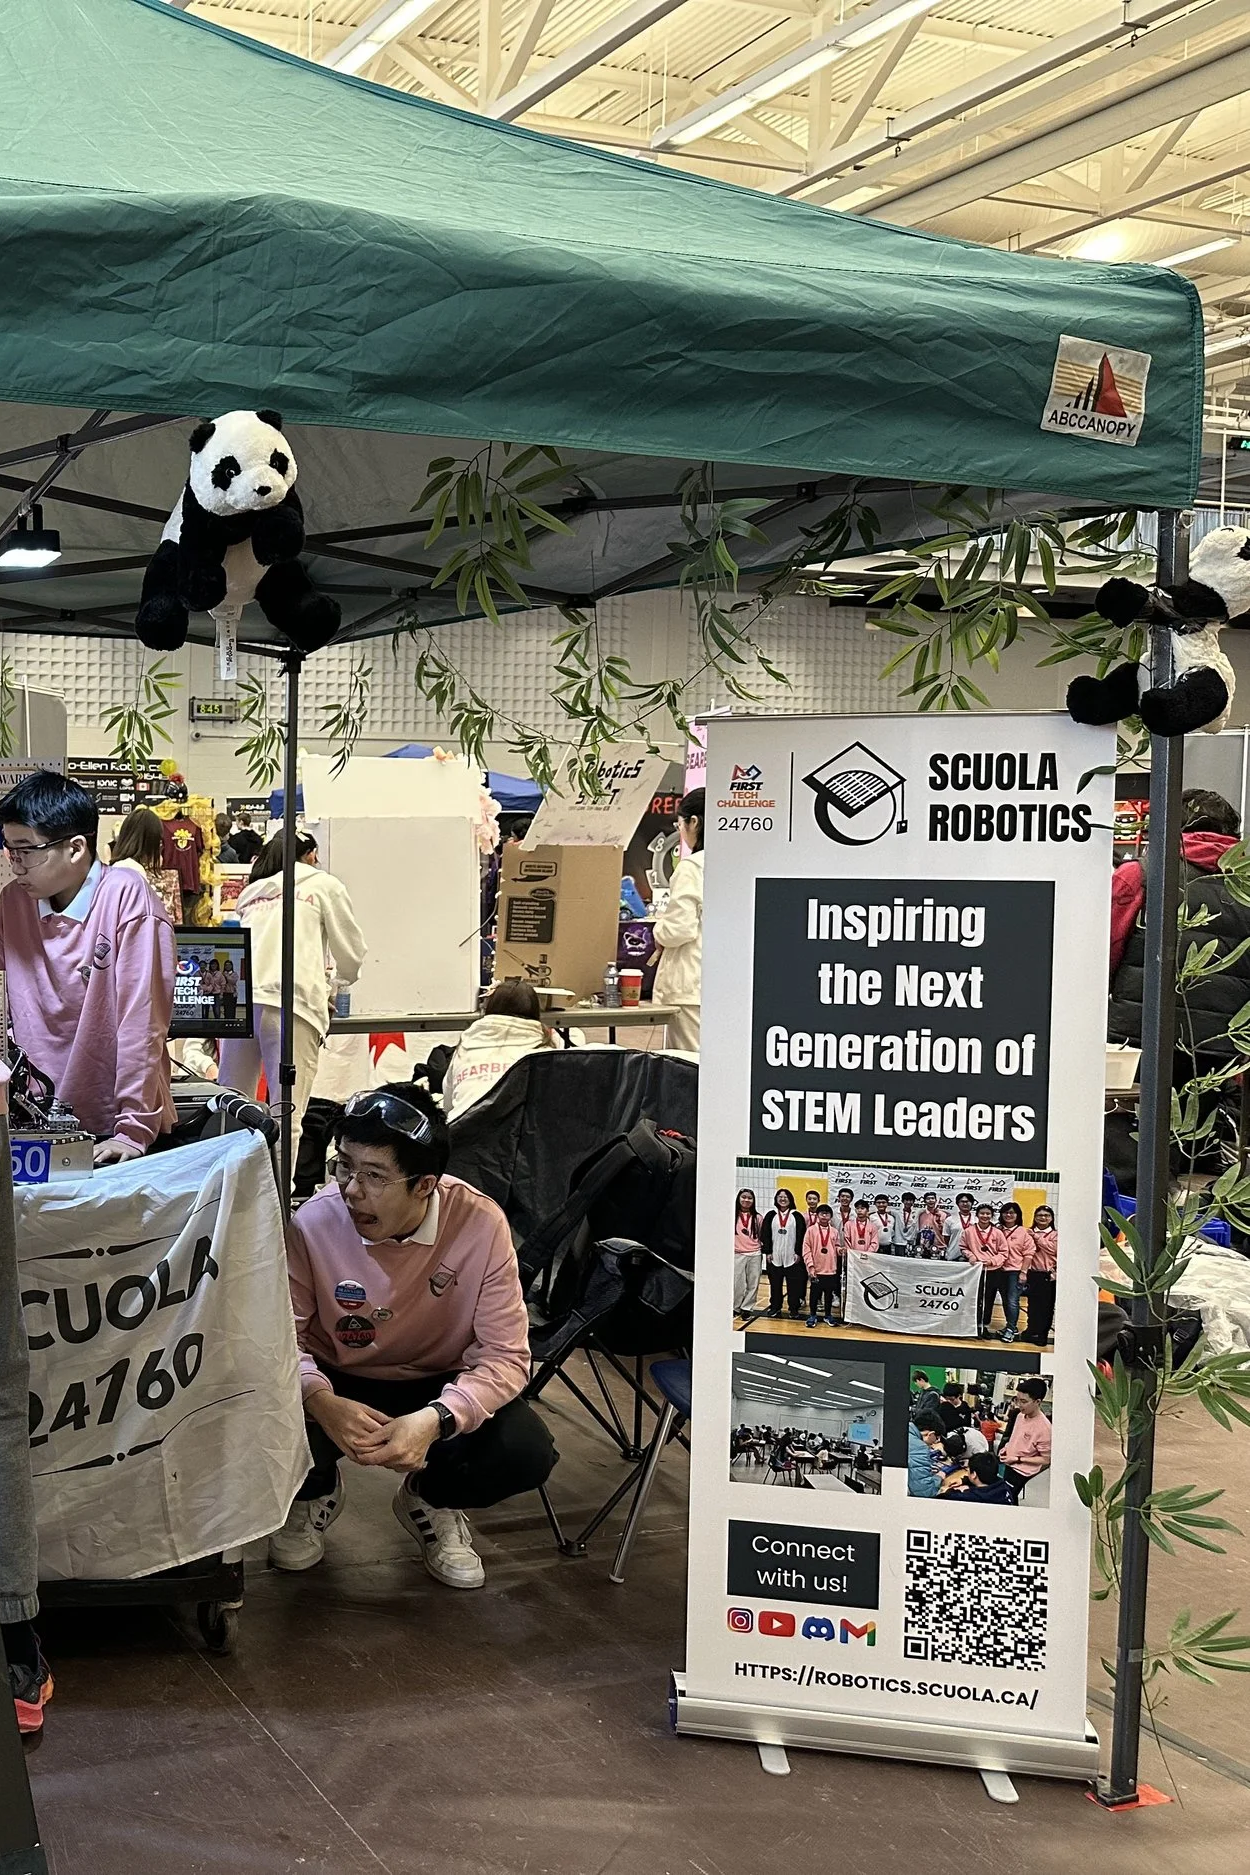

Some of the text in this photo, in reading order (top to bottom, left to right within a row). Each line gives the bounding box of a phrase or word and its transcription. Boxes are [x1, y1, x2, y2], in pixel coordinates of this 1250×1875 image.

[1048, 409, 1137, 439] ABCCANOPY
[929, 753, 1060, 791] SCUOLA
[729, 782, 764, 791] FIRST
[716, 799, 776, 808] CHALLENGE
[717, 816, 774, 832] 24760
[929, 803, 1092, 842] ROBOTICS
[807, 897, 986, 947] Inspiring
[818, 962, 984, 1008] the Next
[765, 1025, 1037, 1076] Generation of
[761, 1089, 1036, 1142] STEM Leaders
[885, 1180, 902, 1188] FIRST
[936, 1182, 955, 1190] FIRST
[988, 1185, 1007, 1193] FIRST
[20, 1235, 219, 1350] CUOLA
[914, 1284, 965, 1297] SCUOLA
[918, 1299, 960, 1311] 24760
[751, 1535, 856, 1563] Connect
[757, 1568, 848, 1593] with us!
[735, 1662, 1040, 1710] HTTPS://ROBOTICS.SCUOLA.CA/
